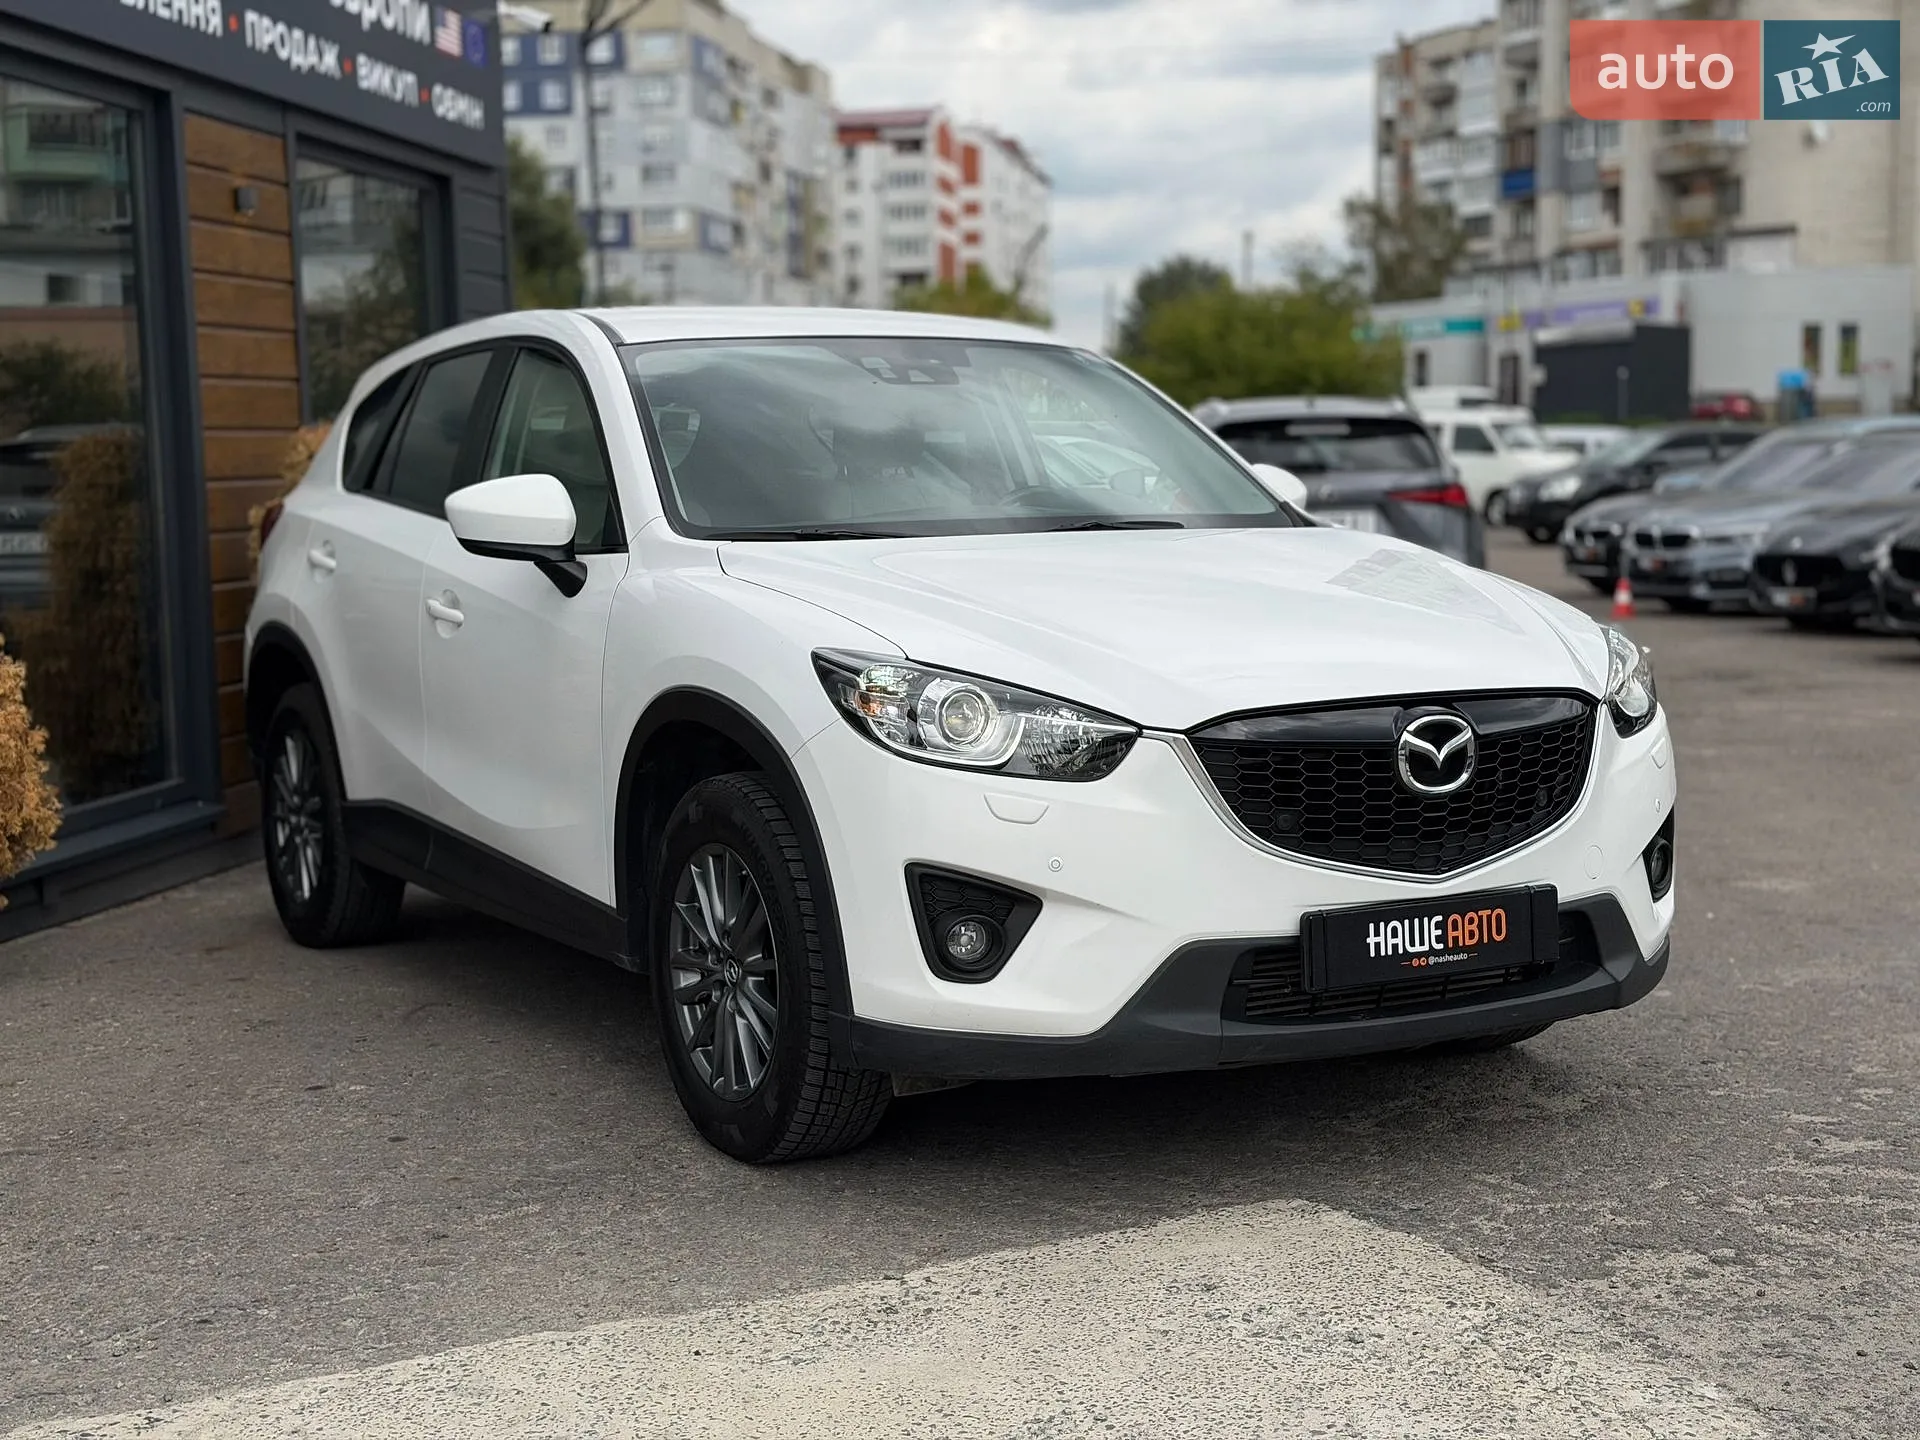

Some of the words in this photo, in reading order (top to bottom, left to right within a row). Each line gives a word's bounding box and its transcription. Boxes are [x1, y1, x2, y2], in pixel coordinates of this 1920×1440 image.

[244, 8, 342, 81] ПРОДАЖ
[356, 52, 419, 108] ВИКУП
[1428, 952, 1468, 966] @nasheauto
